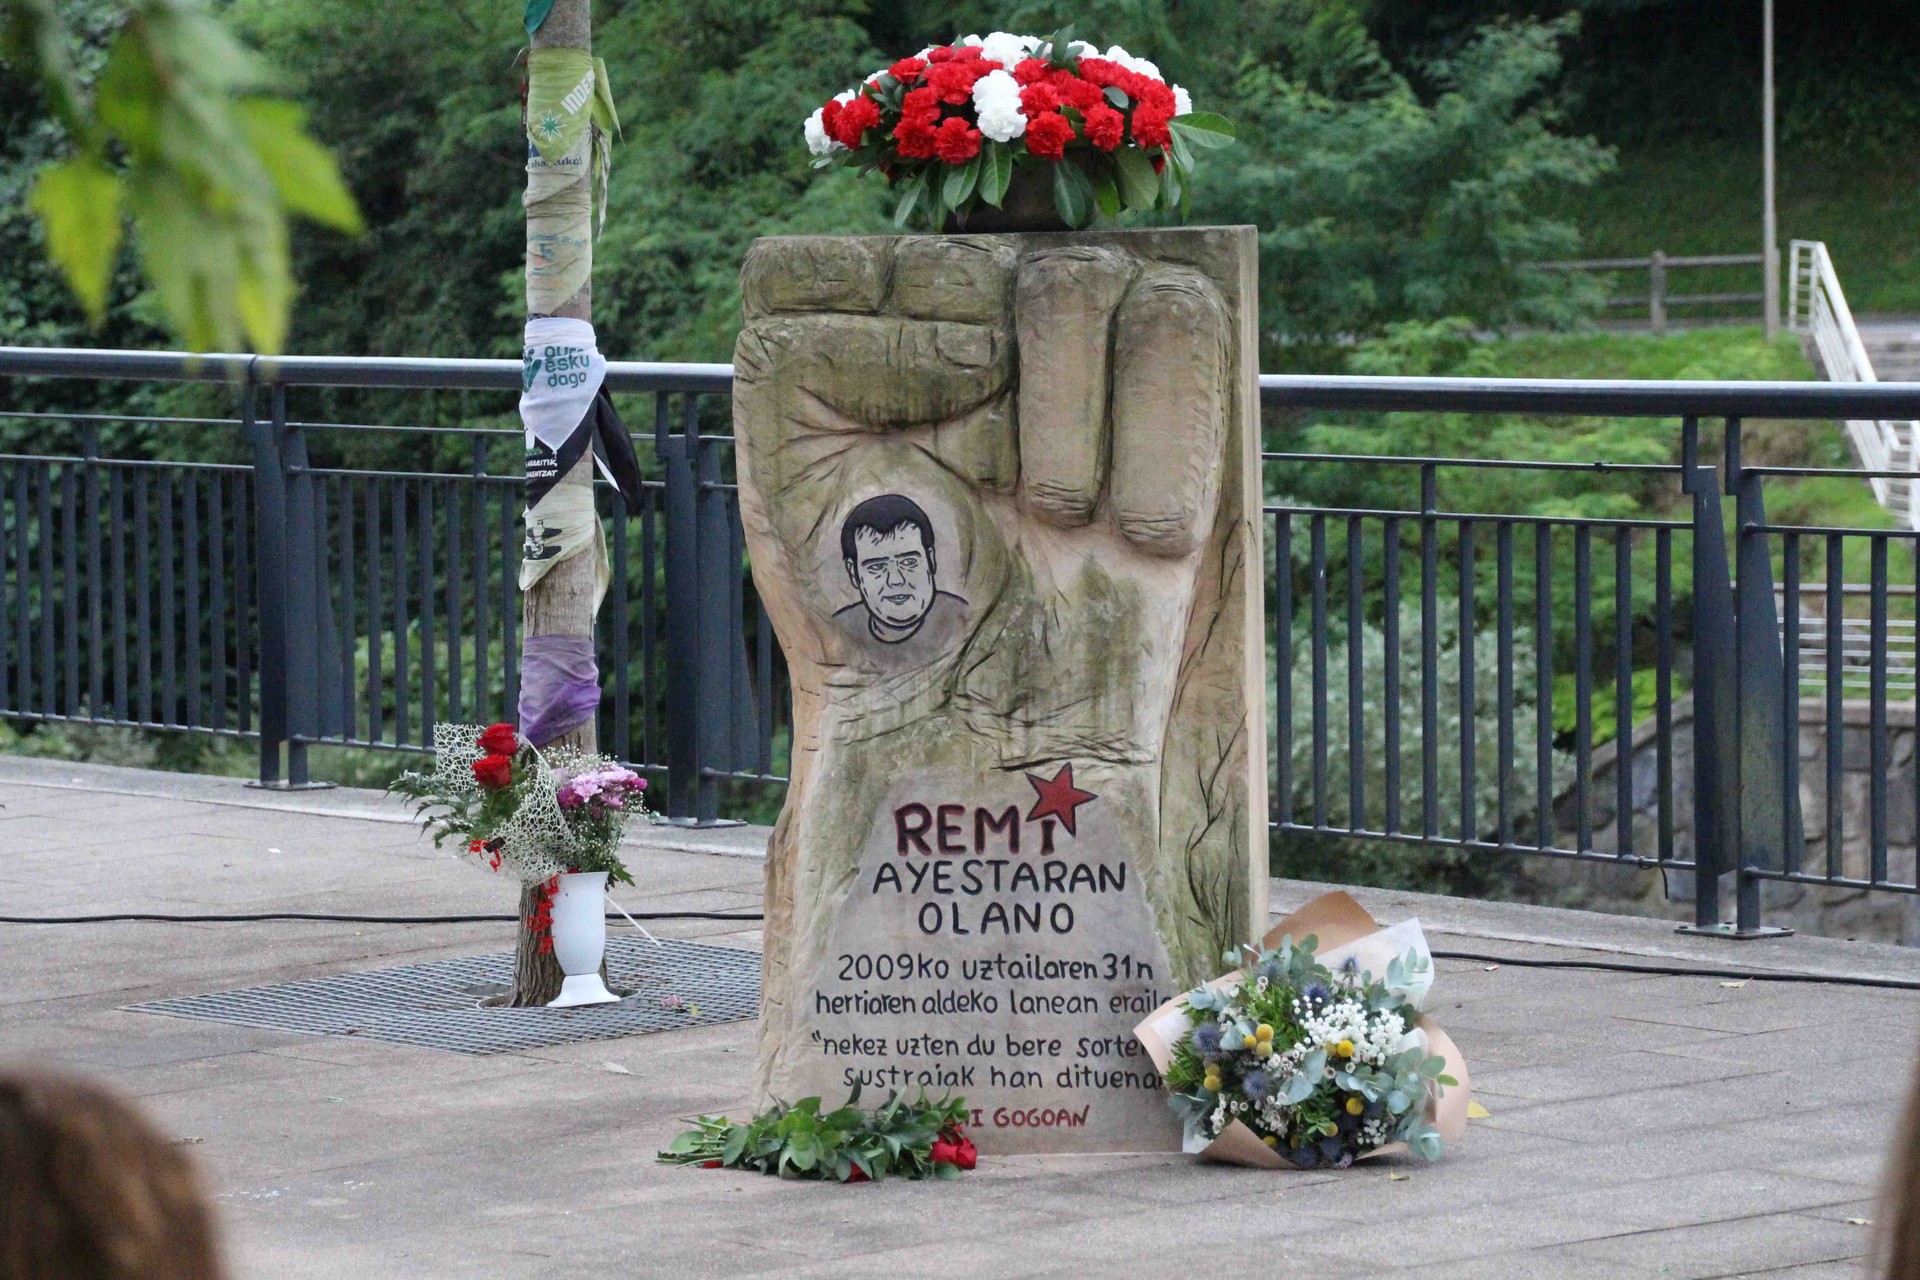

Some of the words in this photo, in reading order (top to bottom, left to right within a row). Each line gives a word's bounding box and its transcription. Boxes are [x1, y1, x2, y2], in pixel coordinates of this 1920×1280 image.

[545, 355, 590, 373] esku
[547, 371, 587, 388] dago
[893, 801, 1057, 857] REMI
[872, 859, 1126, 895] AYESTARAN
[917, 901, 1075, 936] OLANO
[838, 953, 950, 981] 2009ko
[962, 953, 1098, 981] uztailaren
[1102, 952, 1154, 981] 31n
[815, 989, 917, 1015] herriaren
[921, 989, 999, 1016] aldeko
[1009, 988, 1098, 1014] lanean
[895, 1033, 960, 1057] uzten
[966, 1033, 995, 1056] du
[1006, 1033, 1062, 1057] bere
[843, 1064, 975, 1089] sustraiak
[990, 1065, 1043, 1089] han
[993, 1104, 1090, 1129] GOGOAN
